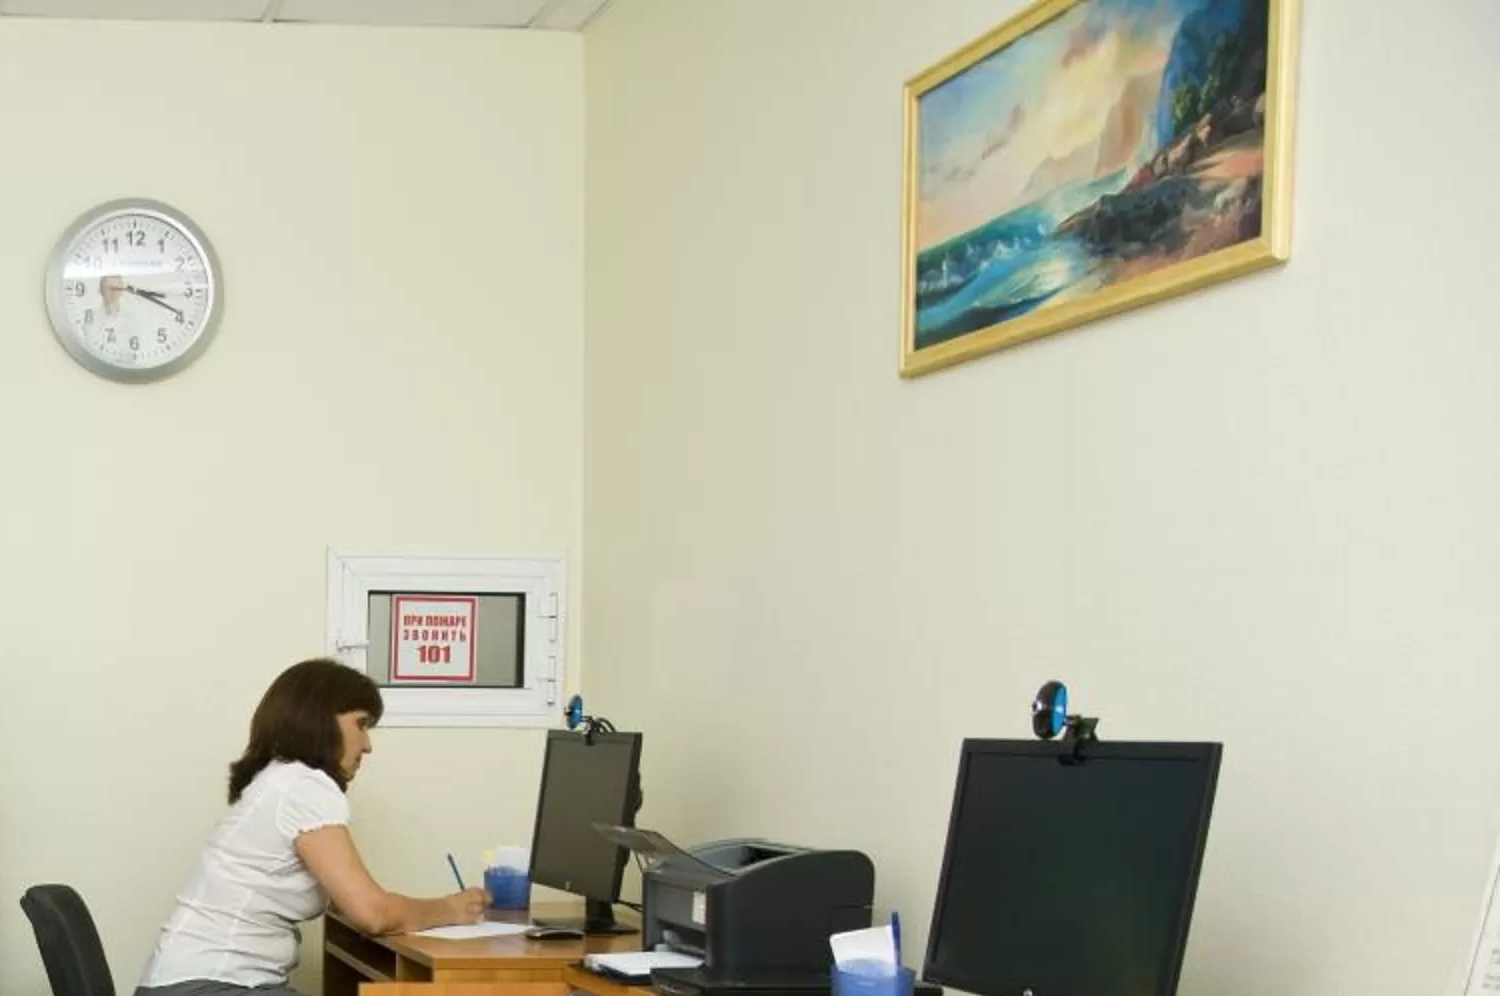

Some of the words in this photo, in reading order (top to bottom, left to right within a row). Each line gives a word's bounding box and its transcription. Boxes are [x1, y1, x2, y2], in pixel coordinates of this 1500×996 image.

[102, 238, 119, 253] 11
[126, 230, 146, 247] 12
[158, 239, 166, 253] 1
[175, 256, 186, 273] 2
[75, 282, 85, 297] 9
[184, 283, 193, 299] 3
[84, 309, 94, 324] 8
[174, 309, 185, 325] 4
[105, 328, 116, 344] 7
[130, 336, 139, 350] 6
[157, 328, 167, 343] 5
[403, 615, 423, 627] ПРИ
[426, 615, 467, 627] ПОЖАРЕ
[403, 629, 467, 642] ЗВОНИТЬ
[417, 645, 451, 663] 101
